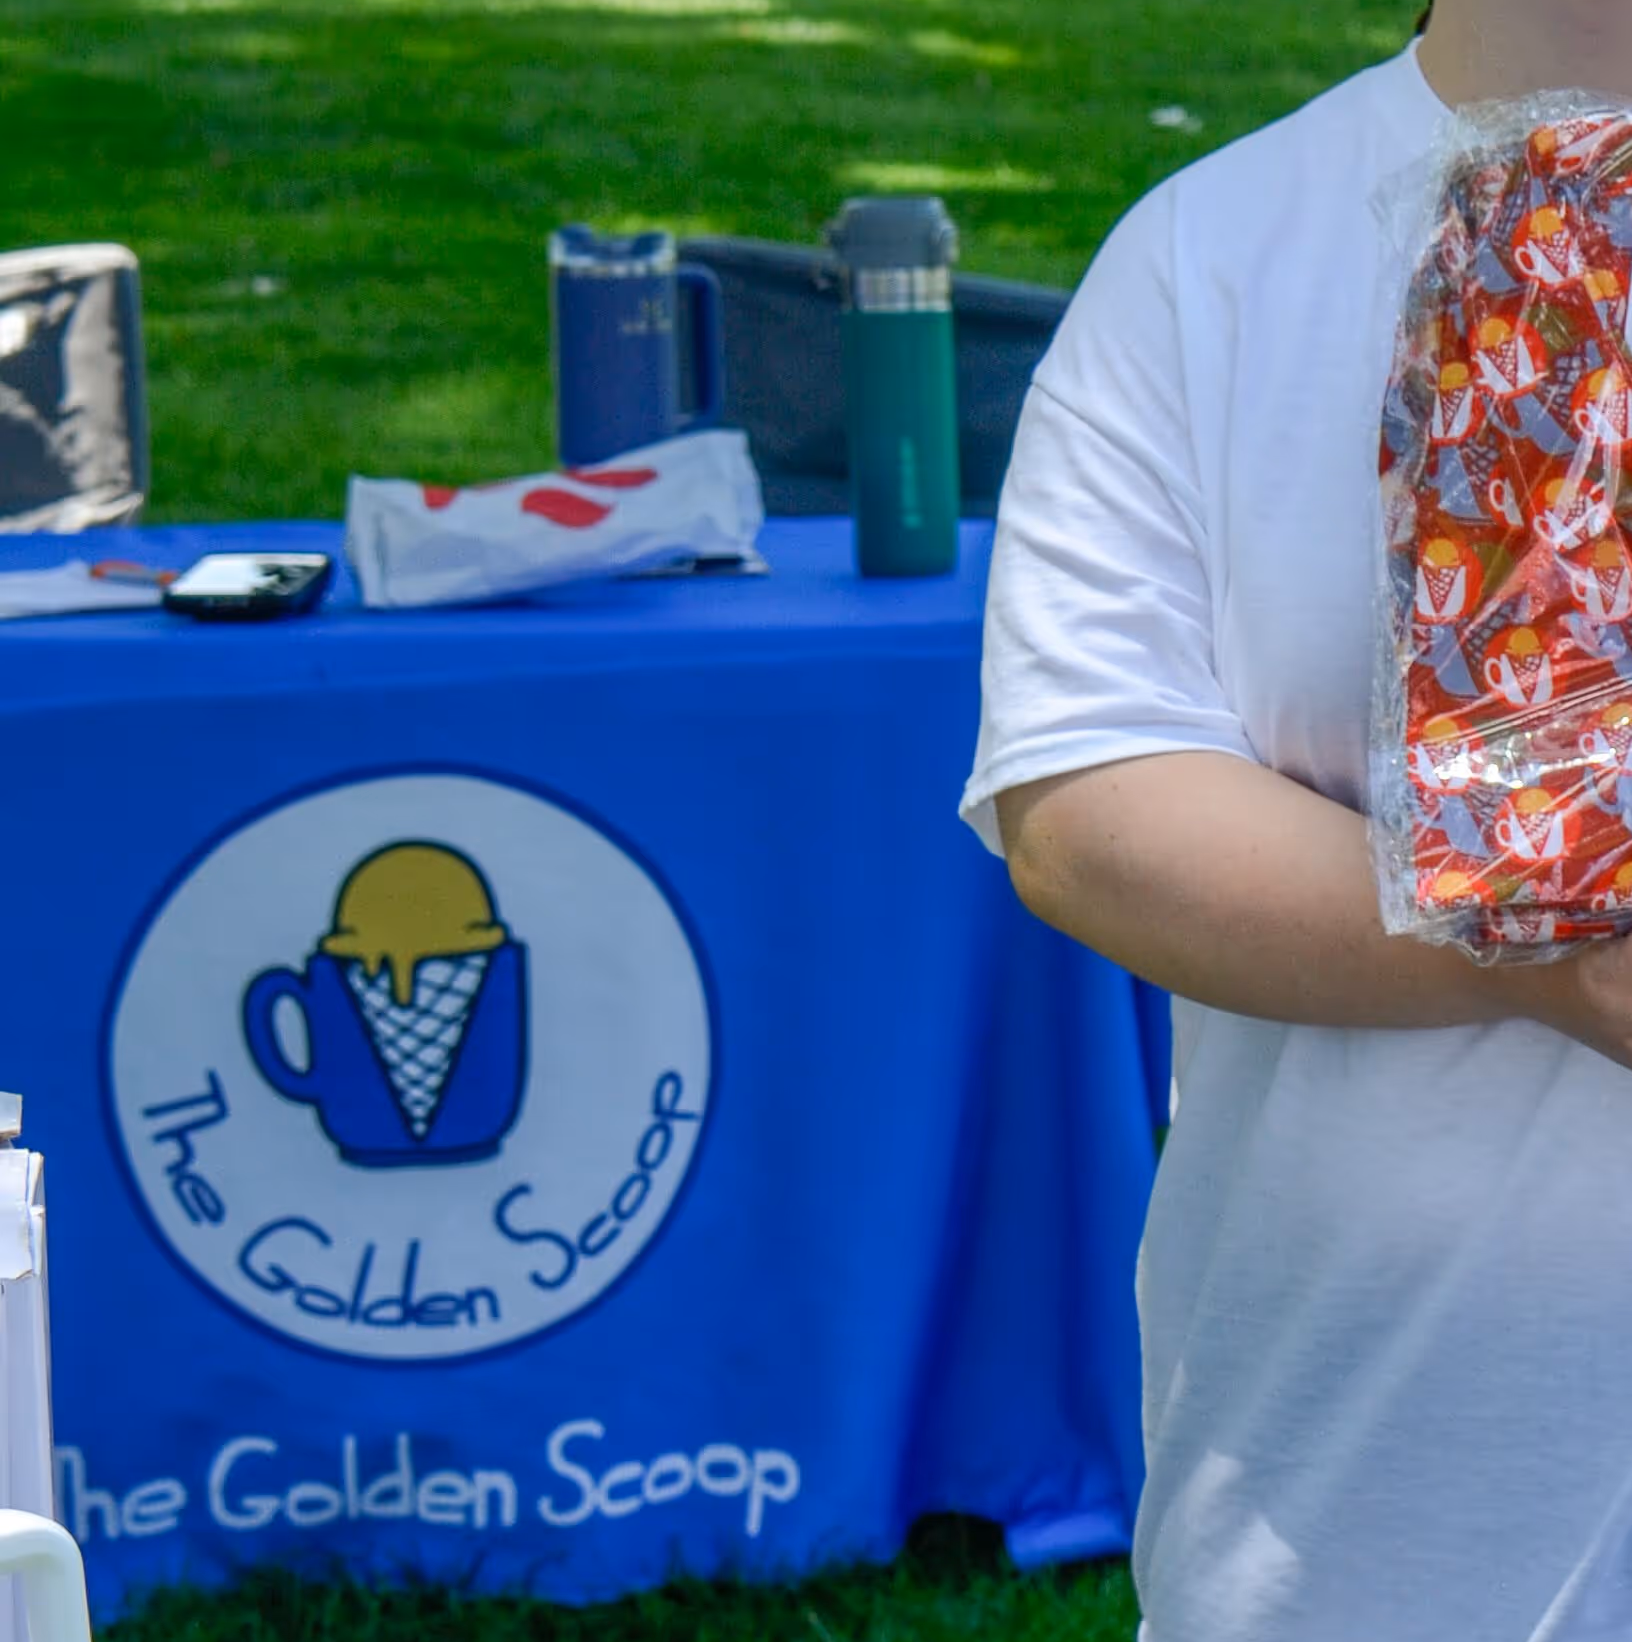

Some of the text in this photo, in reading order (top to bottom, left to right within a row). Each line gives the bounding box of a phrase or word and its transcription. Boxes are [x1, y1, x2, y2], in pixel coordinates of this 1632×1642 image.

[142, 1068, 702, 1327] The Golden Scoop
[209, 1435, 518, 1531] Golden
[537, 1418, 801, 1538] Scoop
